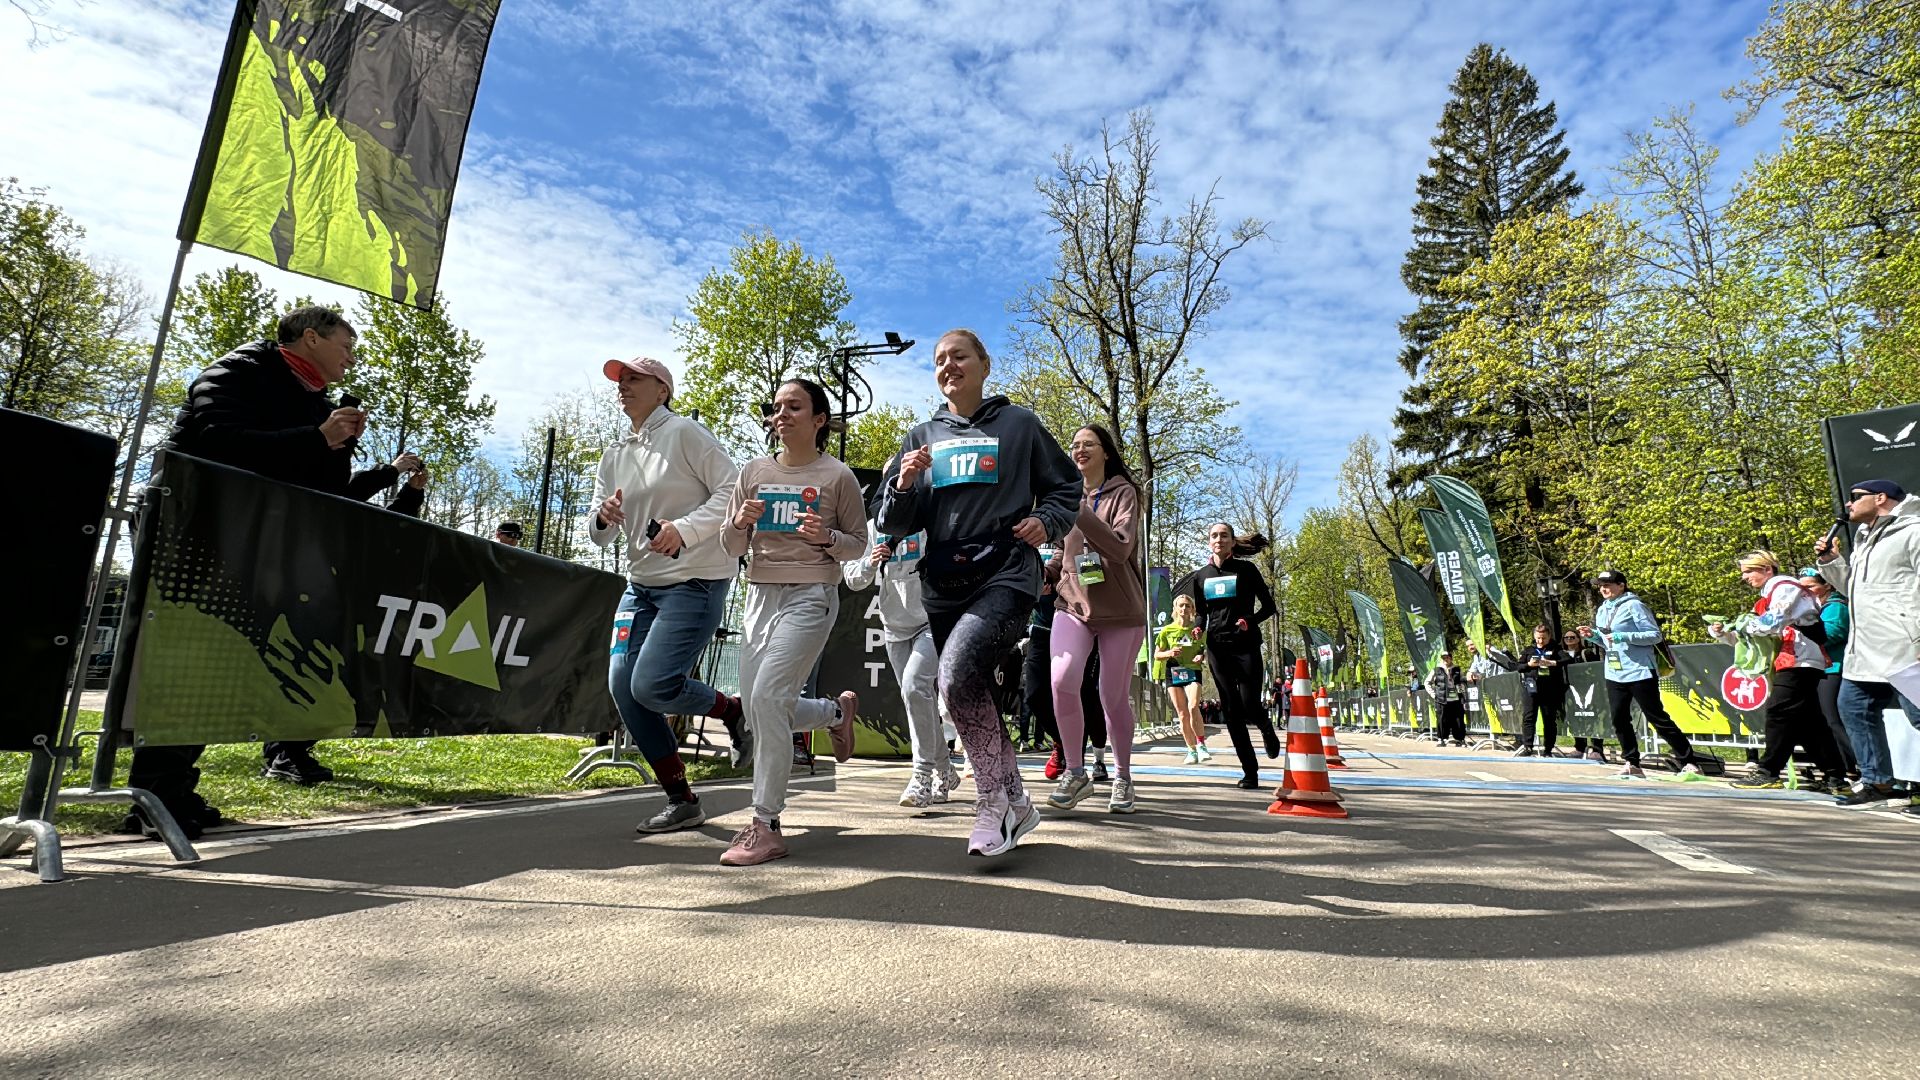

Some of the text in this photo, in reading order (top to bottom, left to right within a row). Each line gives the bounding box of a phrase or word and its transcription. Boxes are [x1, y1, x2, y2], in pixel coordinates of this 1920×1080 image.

[949, 452, 979, 477] 117
[772, 500, 800, 525] 116
[374, 582, 530, 691] TRAIL
